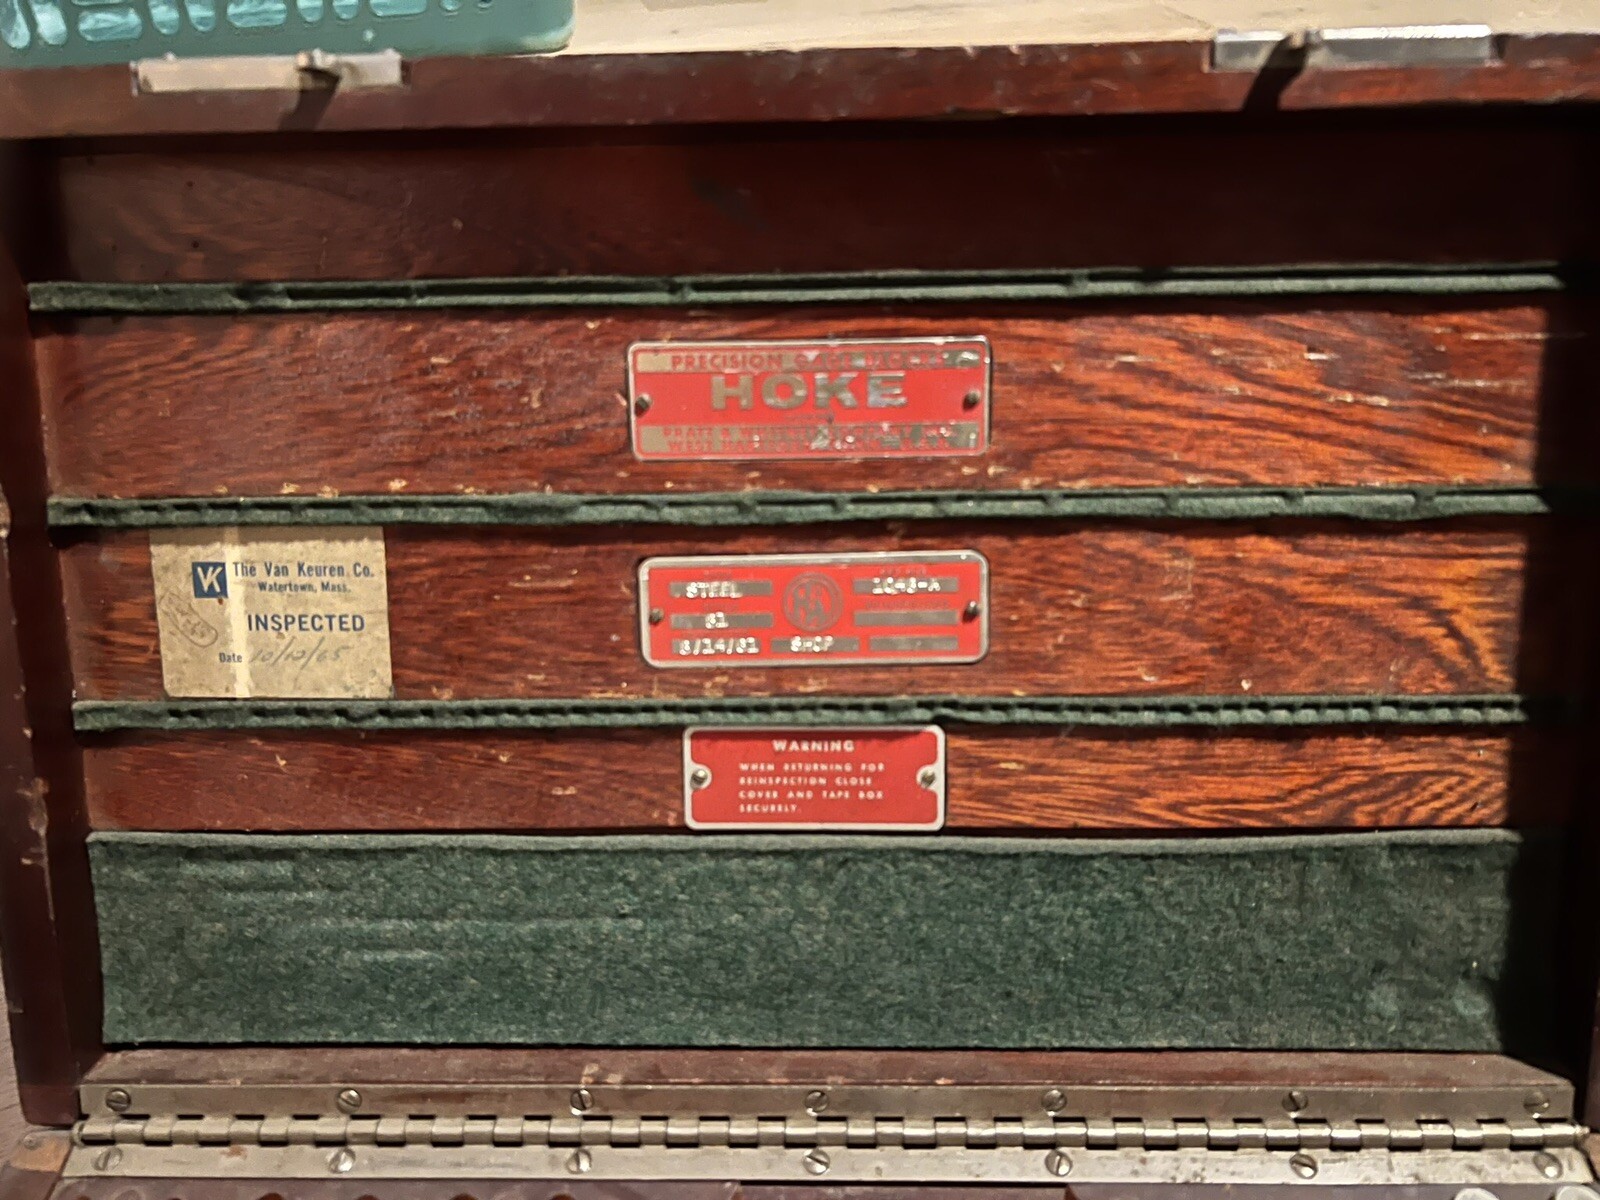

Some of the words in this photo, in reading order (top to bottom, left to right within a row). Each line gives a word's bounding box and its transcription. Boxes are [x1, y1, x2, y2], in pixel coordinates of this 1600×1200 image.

[671, 354, 783, 371] PRECISION
[711, 371, 908, 410] HOKE
[233, 561, 257, 578] The
[264, 561, 290, 578] Van
[297, 561, 346, 578] Keuren
[353, 561, 376, 578] Co.
[685, 580, 743, 598] STEEL
[247, 613, 366, 632] INSPECTED
[218, 651, 243, 664] Date
[772, 739, 856, 753] WARNING
[739, 762, 776, 772] WHEN
[783, 762, 854, 773] RETURNING
[861, 762, 886, 773] FOR
[739, 776, 828, 787] REINSPECTION
[835, 776, 873, 786] CLOSE
[738, 790, 779, 800] COVER
[787, 790, 814, 800] AND
[822, 790, 851, 800] TAPE
[859, 790, 884, 800] BOX
